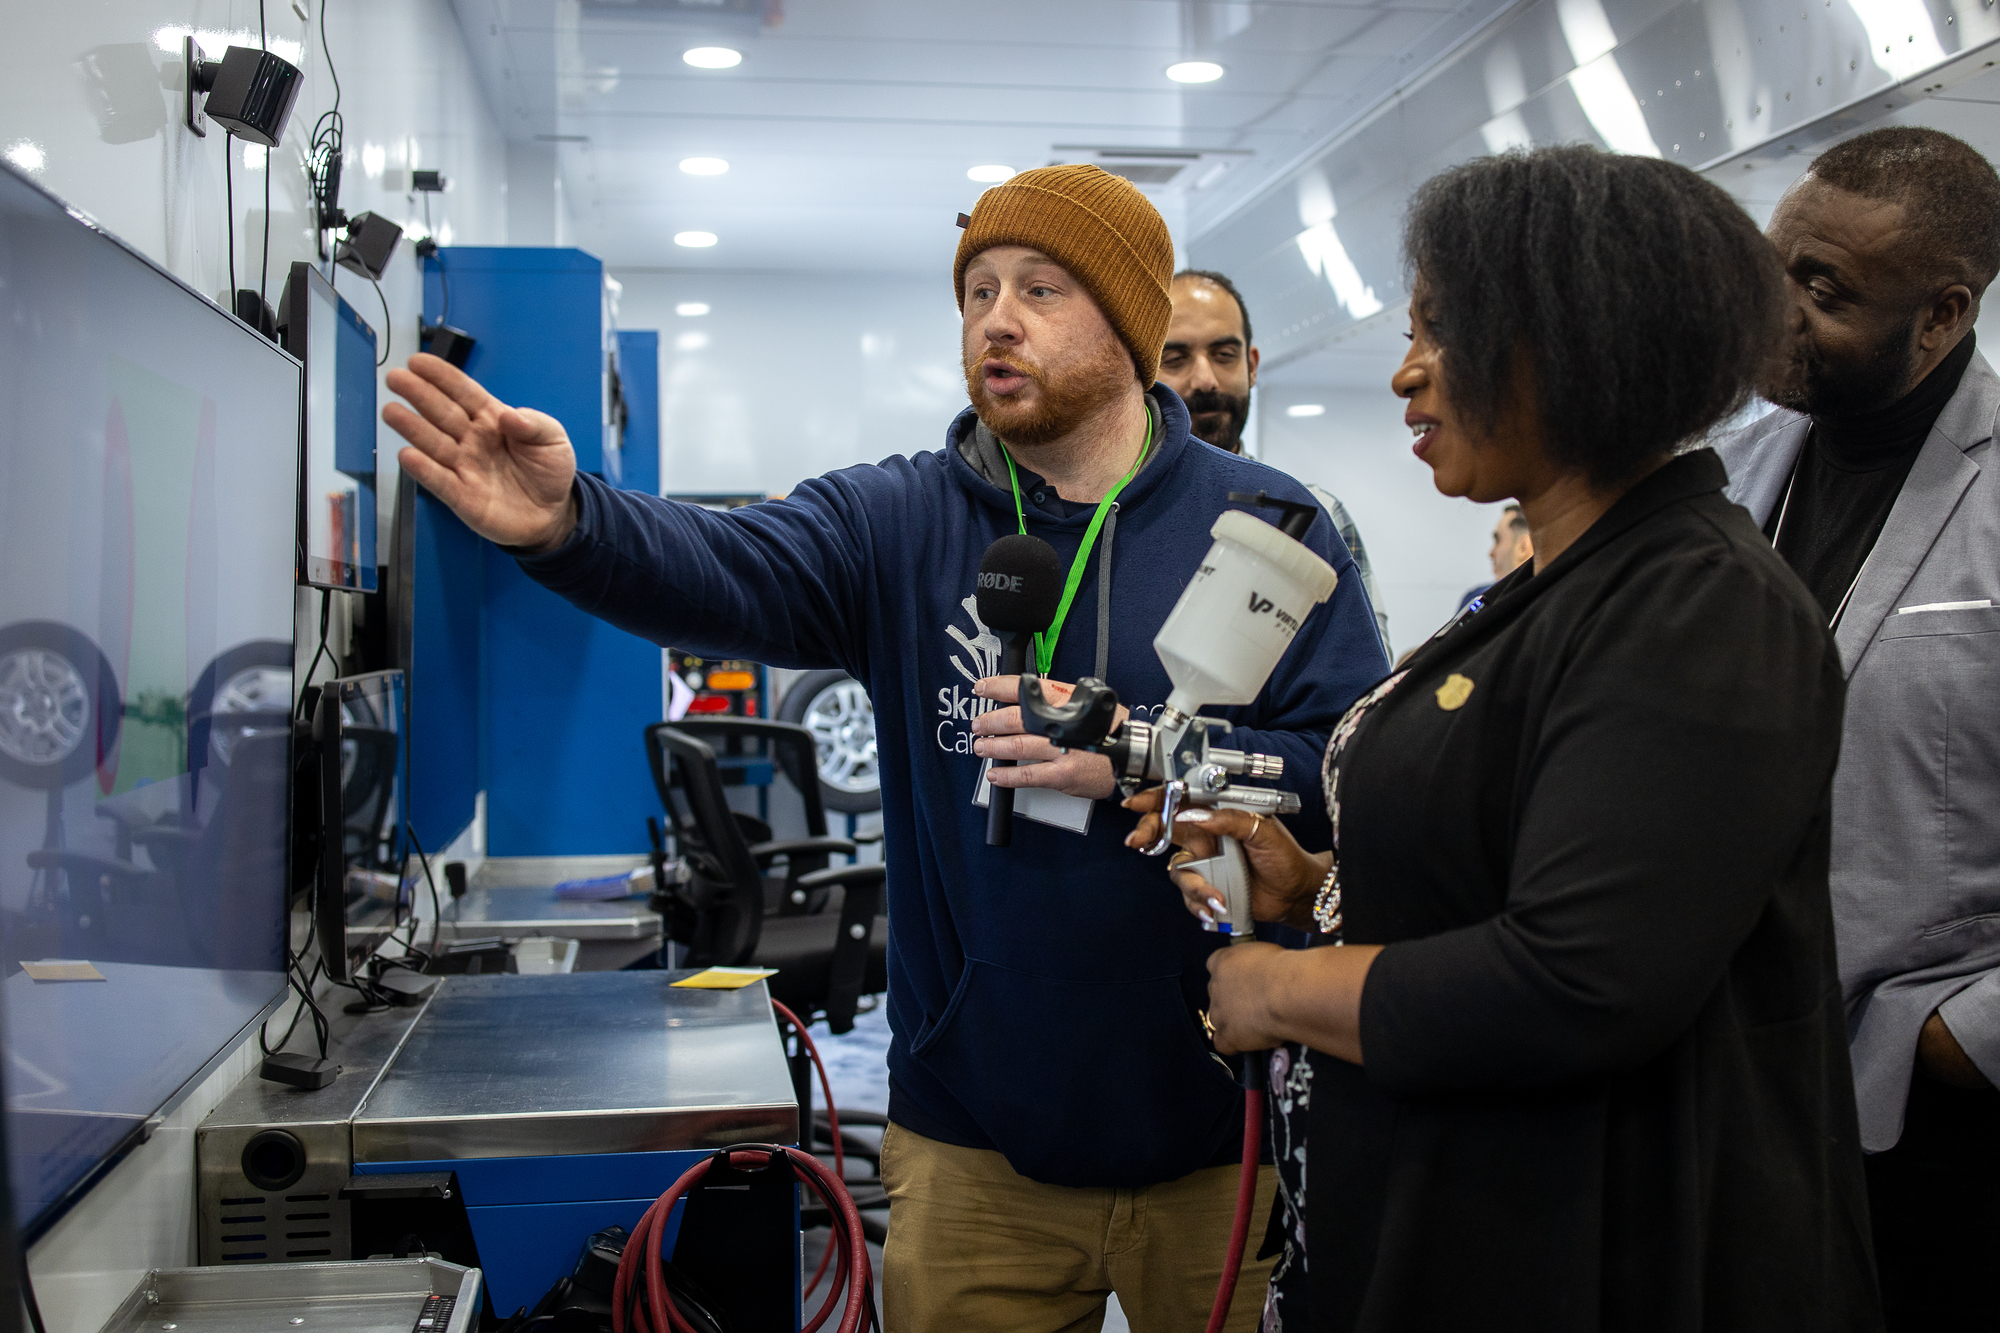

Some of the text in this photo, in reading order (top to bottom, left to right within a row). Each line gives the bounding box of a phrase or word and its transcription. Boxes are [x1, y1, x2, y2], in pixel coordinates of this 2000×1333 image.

[977, 572, 1023, 593] RØDE
[1248, 591, 1275, 614] VP
[938, 685, 997, 721] Skill
